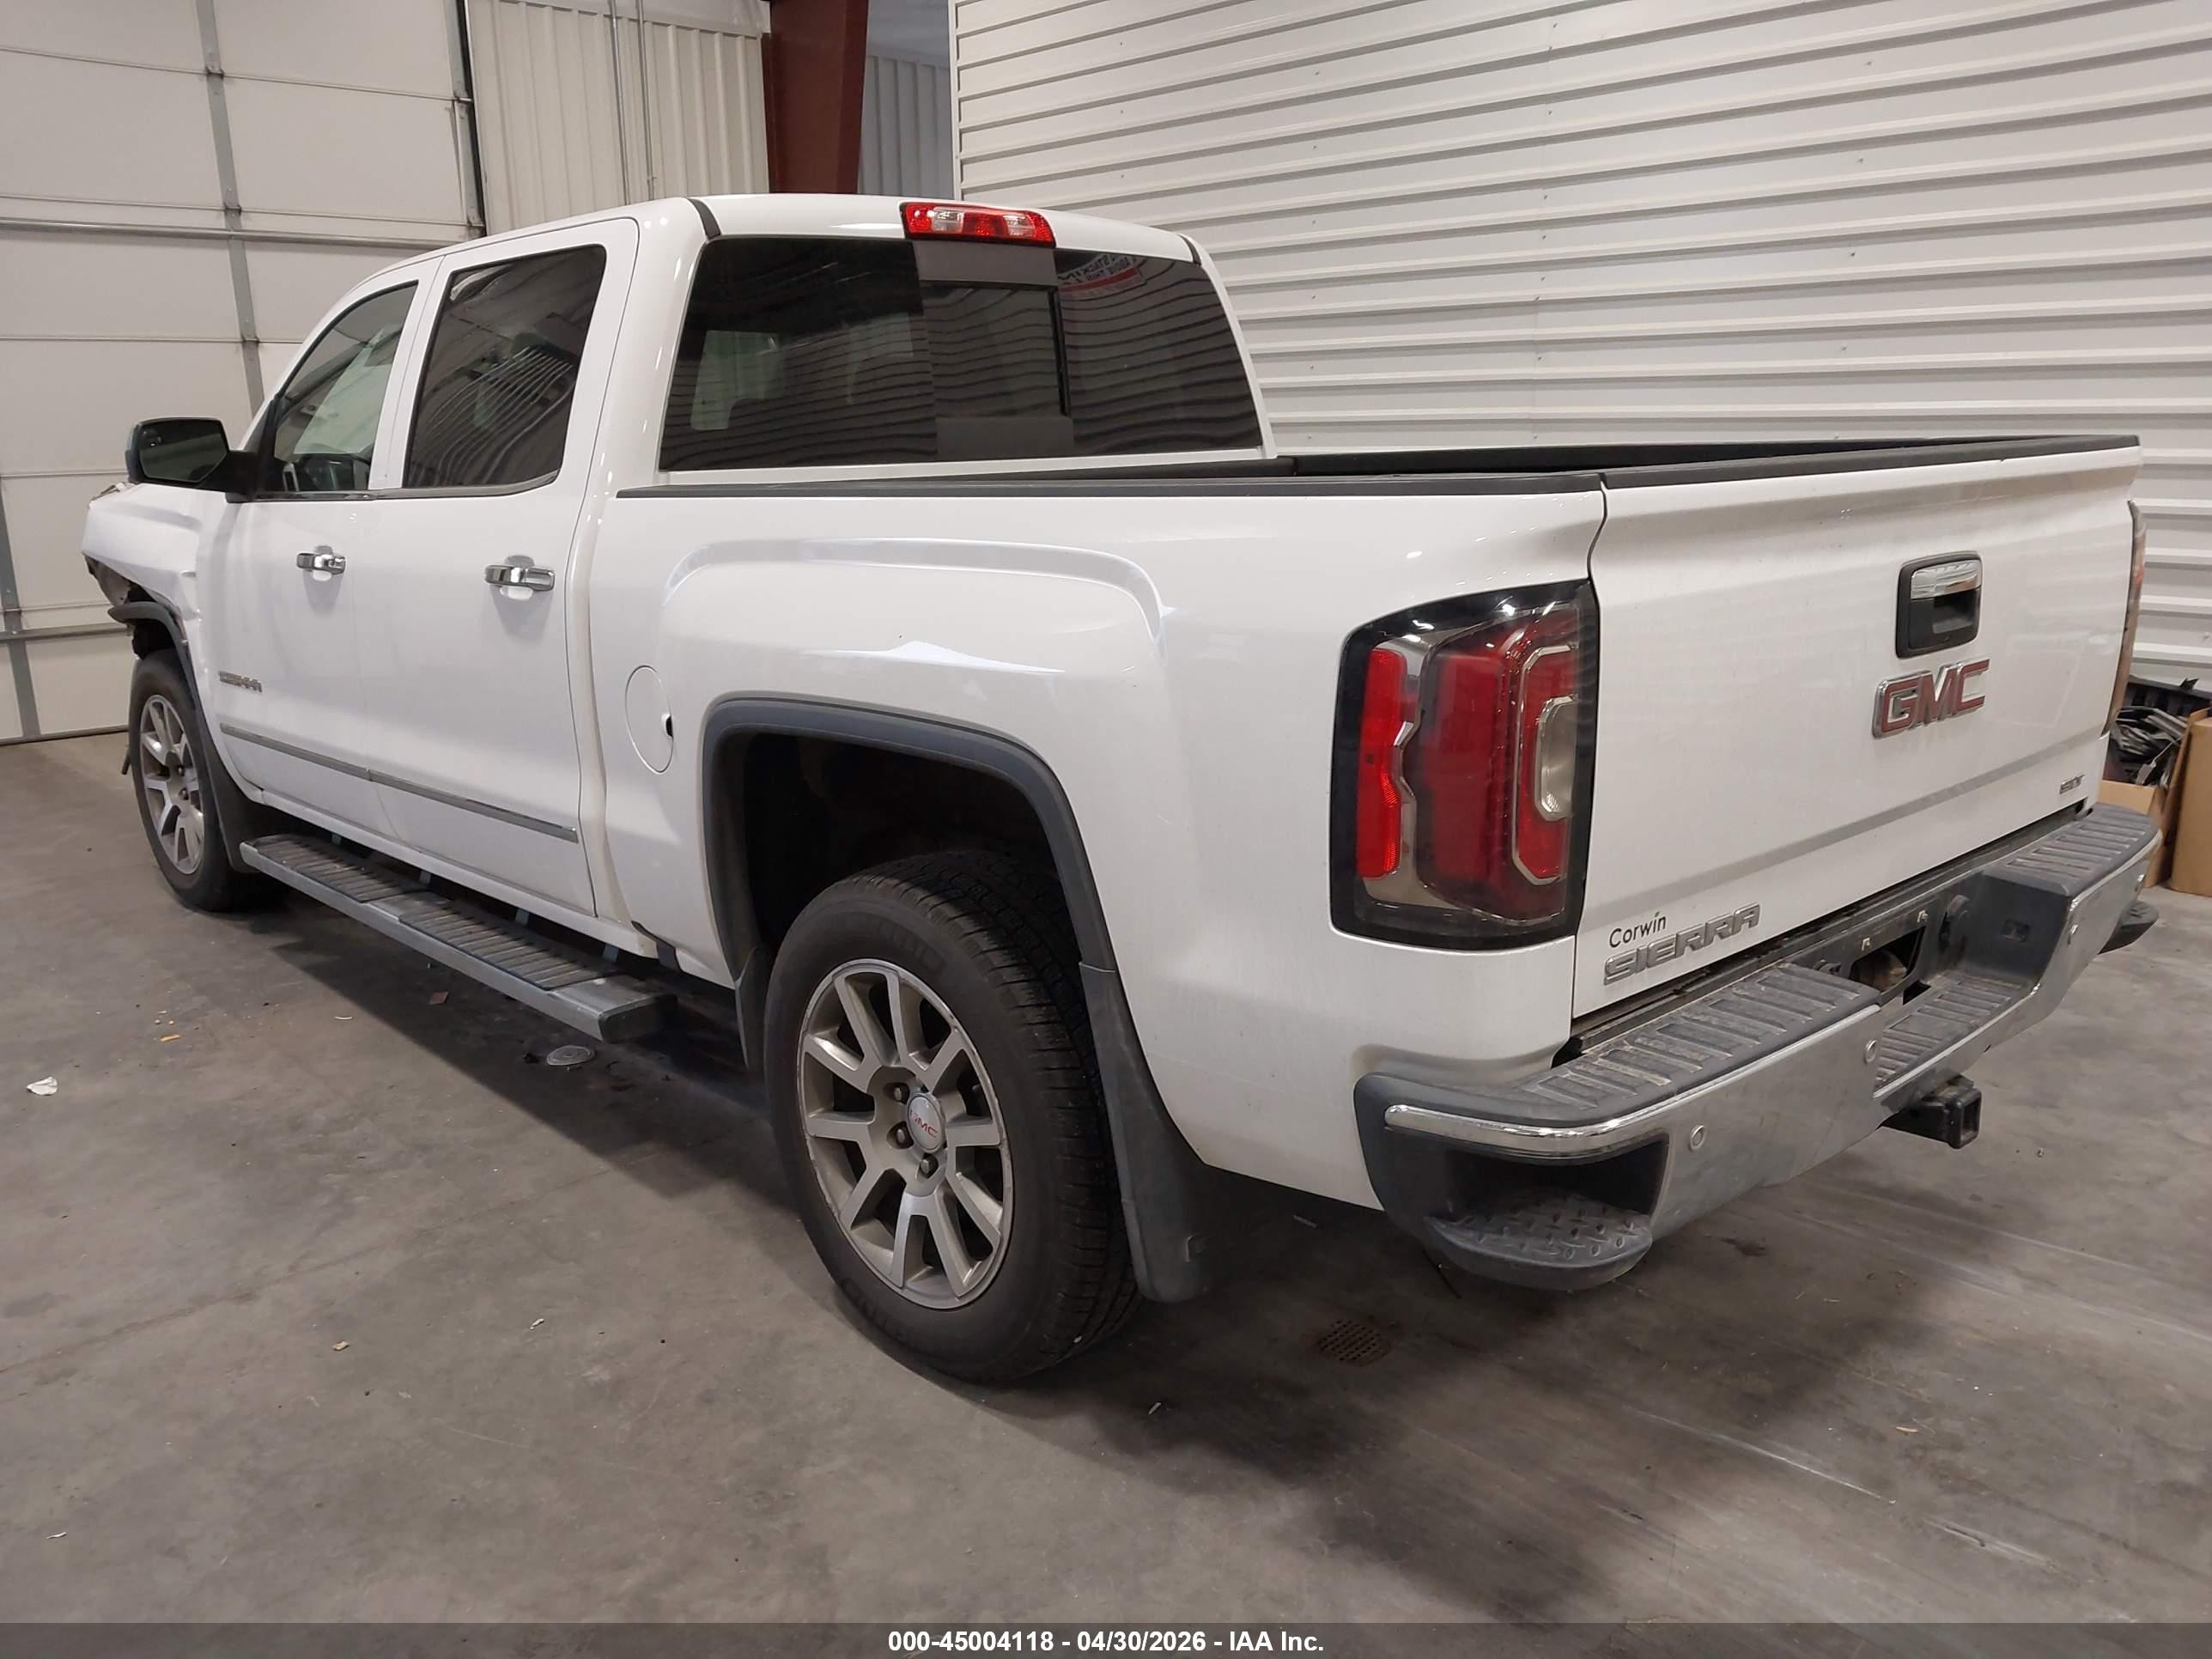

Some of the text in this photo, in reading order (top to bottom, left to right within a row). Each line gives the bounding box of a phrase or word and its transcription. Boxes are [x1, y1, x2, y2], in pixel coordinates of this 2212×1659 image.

[1872, 659, 1990, 739] GMC
[1604, 902, 1760, 985] SIERRA
[1609, 911, 1667, 948] Corwin
